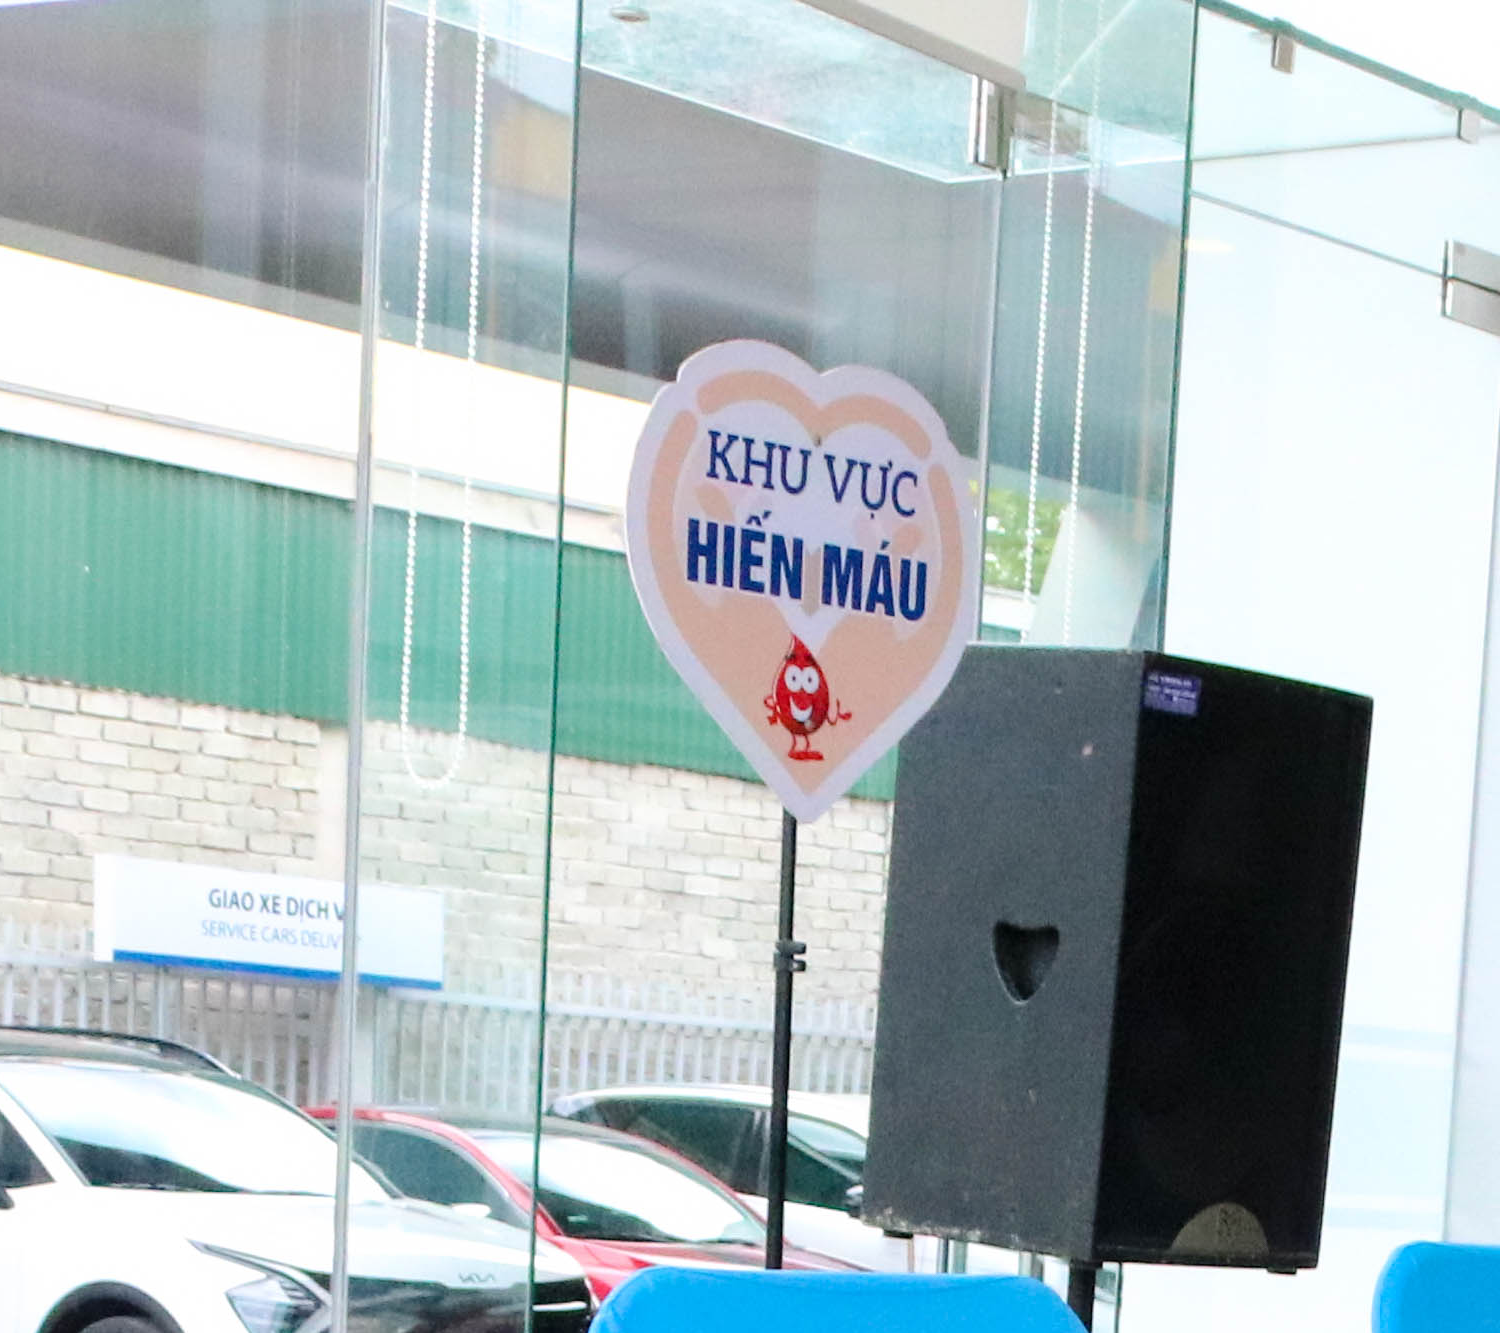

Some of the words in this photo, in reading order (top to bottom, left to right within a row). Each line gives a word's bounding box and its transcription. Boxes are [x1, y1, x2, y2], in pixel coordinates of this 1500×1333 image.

[705, 430, 811, 494] KHU
[824, 455, 919, 519] VỰC
[686, 509, 803, 600] HIẾN
[821, 541, 928, 621] MÁU
[201, 919, 257, 941] SERVICE
[261, 926, 298, 945] CARS
[300, 929, 343, 950] DELIV
[208, 888, 255, 912] GIAO
[260, 893, 282, 915] XE
[286, 897, 330, 922] DỊCH
[333, 901, 346, 921] V
